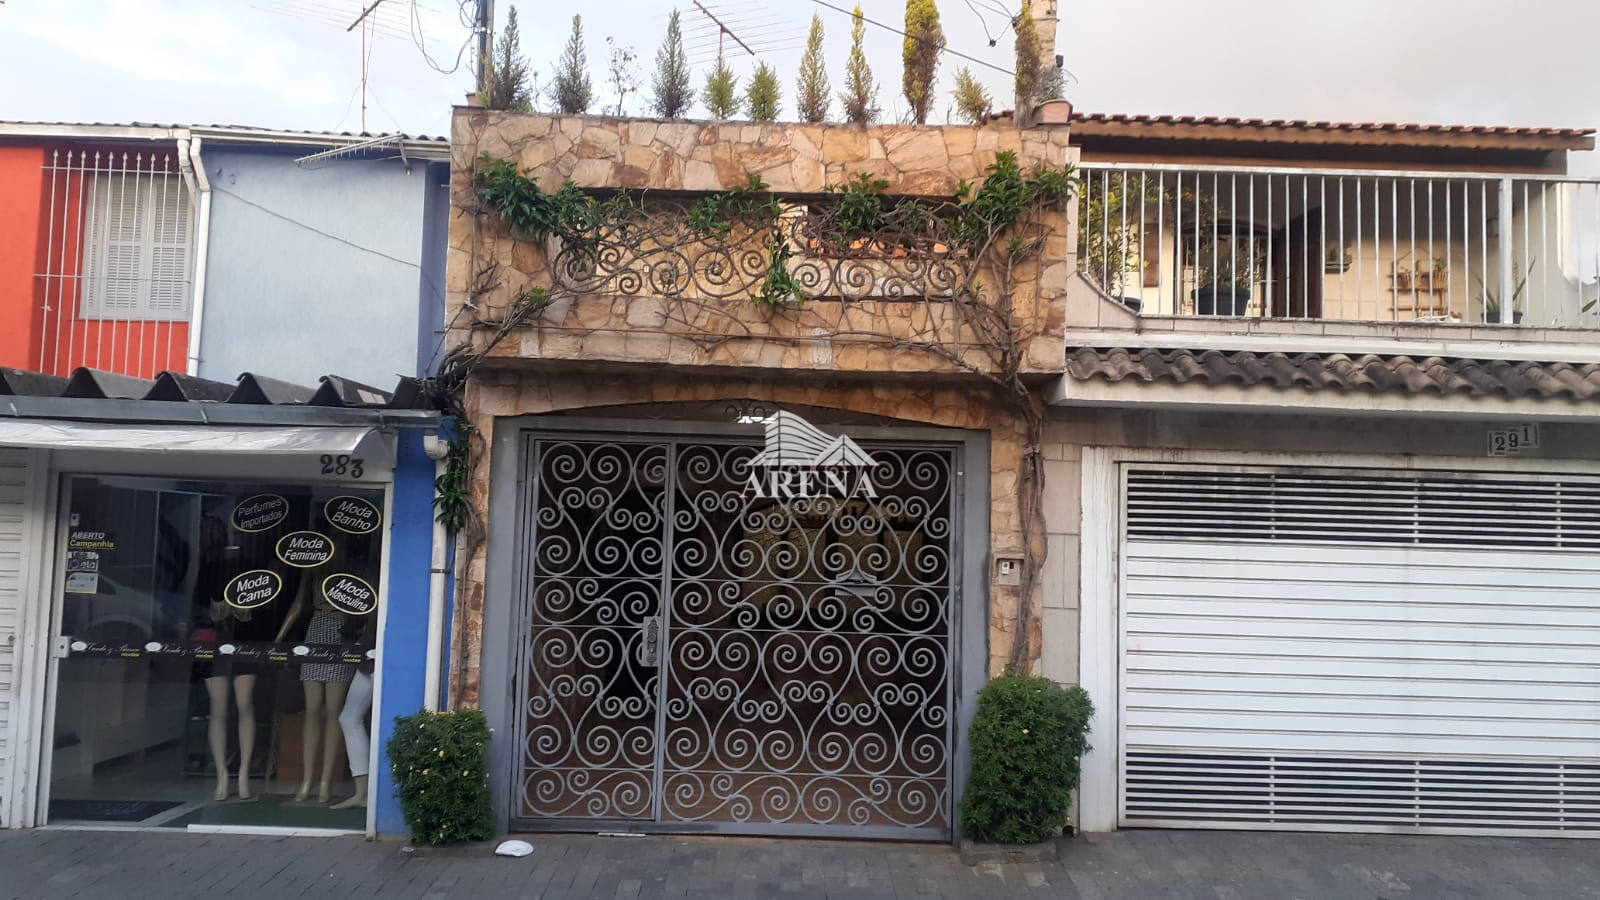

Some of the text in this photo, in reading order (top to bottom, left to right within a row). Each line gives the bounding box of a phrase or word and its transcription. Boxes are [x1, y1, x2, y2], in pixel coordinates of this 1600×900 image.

[1494, 427, 1530, 451] 291
[320, 454, 364, 478] 283
[238, 498, 282, 517] Perfumes
[338, 501, 373, 518] Moda
[240, 510, 282, 529] Importados
[331, 511, 371, 530] Banho
[289, 537, 324, 549] Moda
[284, 549, 327, 561] Feminina
[236, 575, 270, 593] Moda
[336, 578, 370, 600] Moda
[237, 587, 272, 605] Cama
[327, 586, 368, 611] Masculina
